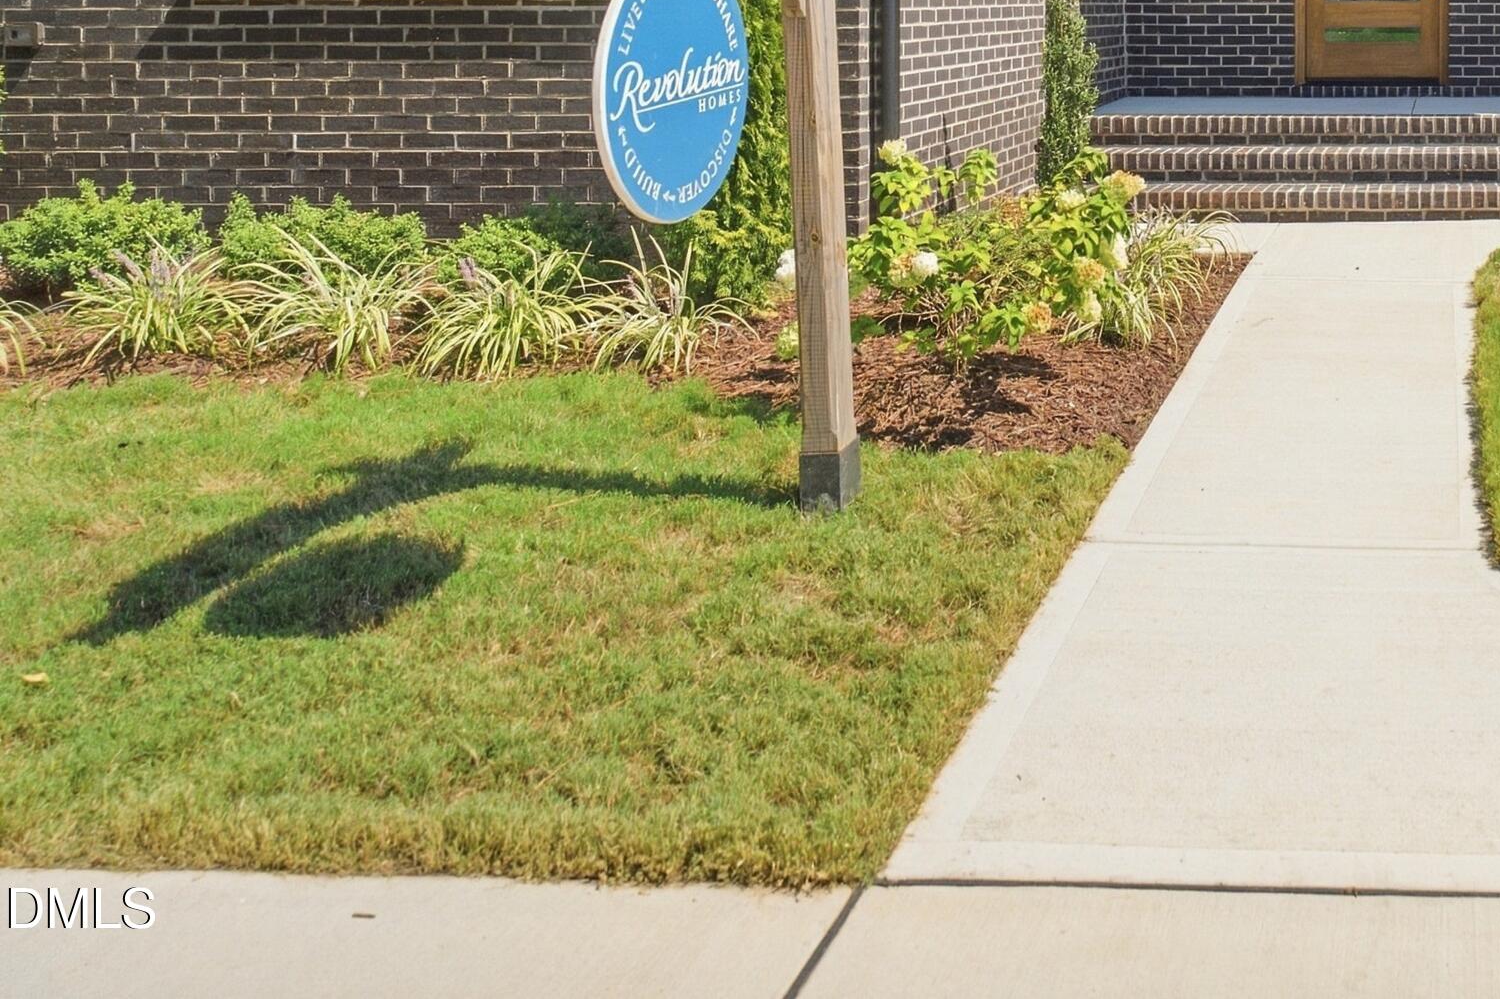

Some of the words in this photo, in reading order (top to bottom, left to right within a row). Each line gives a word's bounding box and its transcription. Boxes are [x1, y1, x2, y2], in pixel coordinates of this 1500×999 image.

[618, 1, 643, 56] LIVE
[610, 47, 744, 132] Revolution
[698, 88, 742, 113] HOMES
[624, 146, 661, 201] BUILD
[678, 130, 733, 203] DISCOVER
